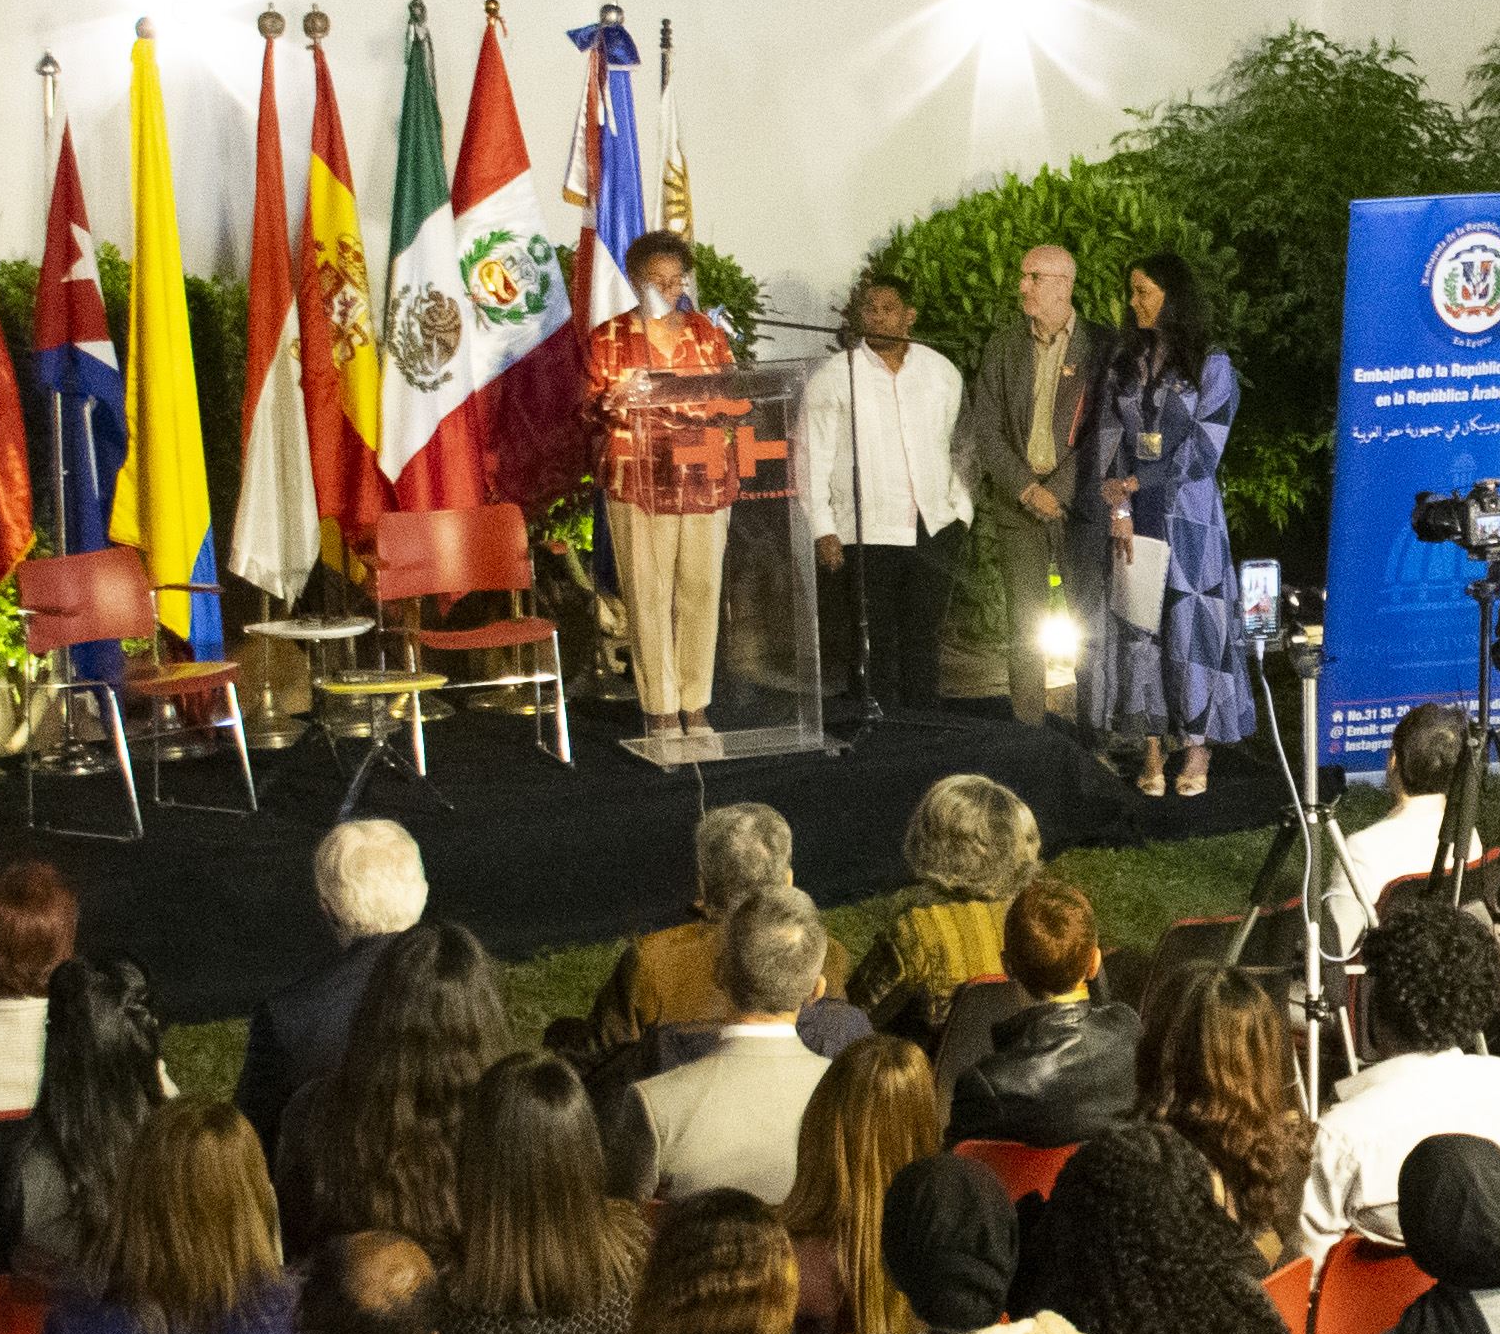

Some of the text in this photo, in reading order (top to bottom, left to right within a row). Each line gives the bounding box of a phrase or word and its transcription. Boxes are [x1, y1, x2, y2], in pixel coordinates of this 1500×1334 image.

[1353, 366, 1415, 384] Embajada
[1416, 364, 1433, 379] de
[1435, 363, 1448, 378] la
[1375, 394, 1392, 408] en
[1393, 392, 1405, 406] la
[1406, 388, 1470, 407] República
[1404, 422, 1443, 439] جمهورية
[1444, 420, 1461, 442] في
[739, 488, 799, 500] Cervante
[1347, 706, 1378, 723] No.31
[1380, 705, 1394, 719] St.
[1346, 723, 1379, 737] Email:
[1345, 738, 1392, 754] Instagra
